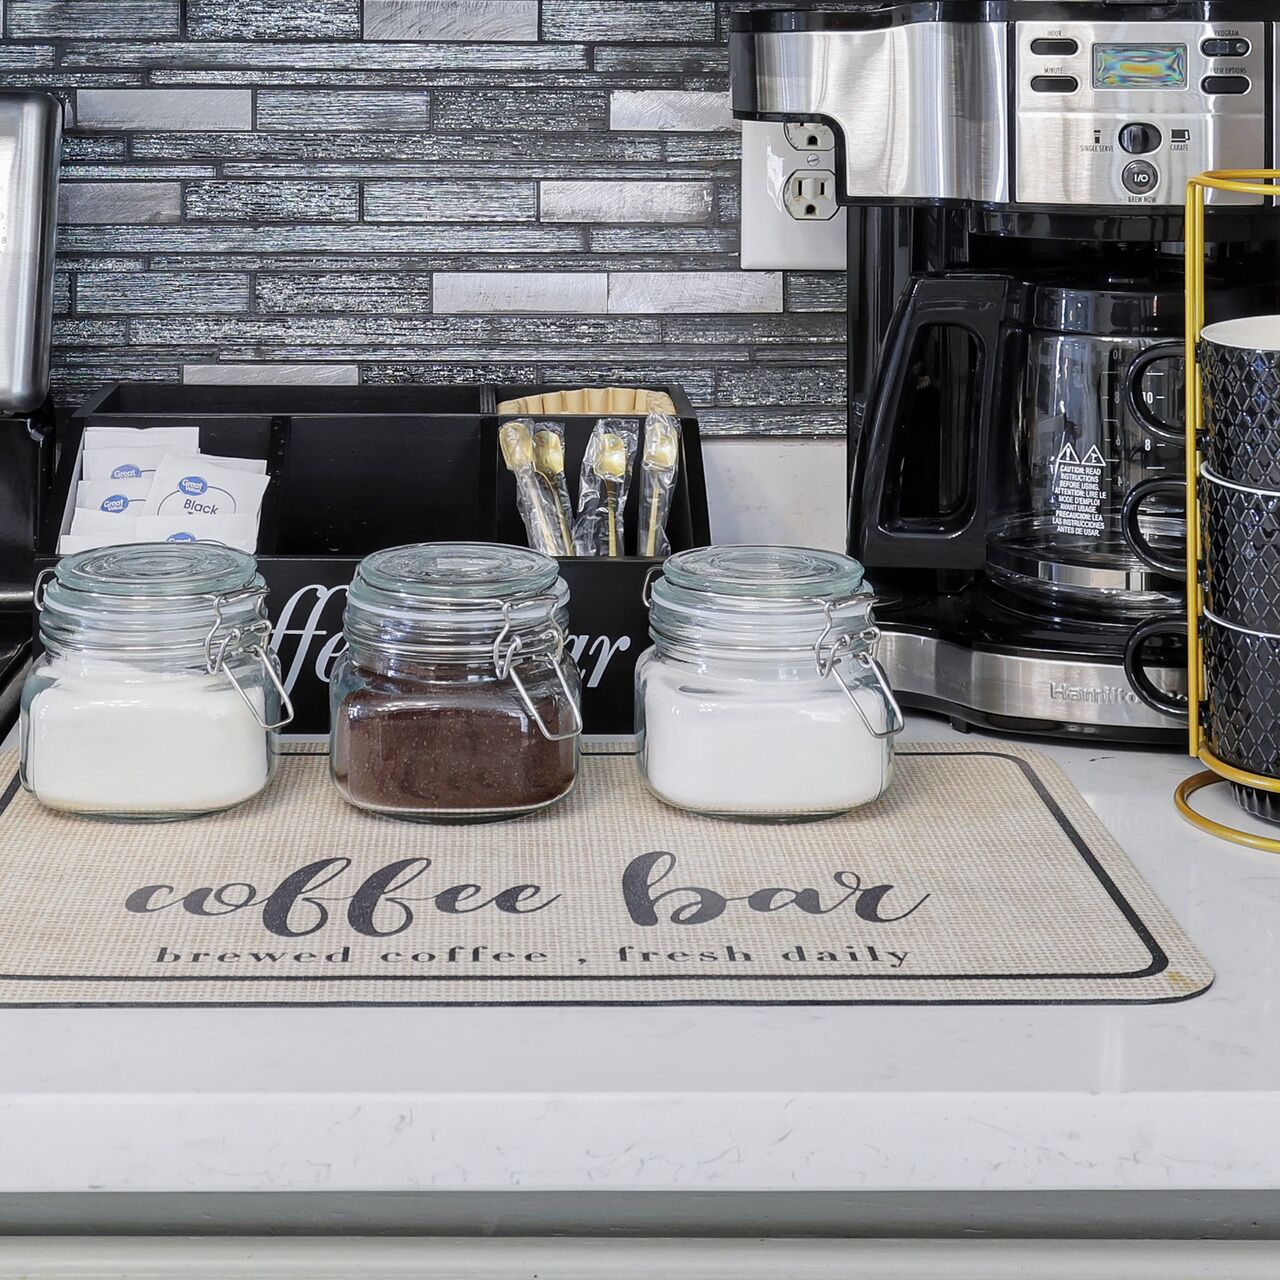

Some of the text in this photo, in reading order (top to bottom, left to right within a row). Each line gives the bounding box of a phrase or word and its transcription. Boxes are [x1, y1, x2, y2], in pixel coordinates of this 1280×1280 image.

[1214, 29, 1240, 37] PROGRAM
[1145, 439, 1151, 451] 8
[113, 469, 136, 478] Great
[1060, 465, 1085, 474] CAUTION:
[1061, 473, 1099, 482] INSTRUCTIONS
[181, 479, 203, 490] Great
[1060, 480, 1080, 489] BEFORE
[1055, 487, 1107, 499] ATTENTION: LIRE LE
[103, 500, 124, 509] Great
[1075, 497, 1100, 506] D'EMPLOI
[183, 498, 219, 515] Black
[1060, 503, 1077, 511] AVANT
[1063, 519, 1105, 529] INSTRUCCIONES
[1057, 525, 1074, 534] ANTES
[563, 634, 631, 688] ar
[1050, 682, 1142, 705] Hamilto
[125, 851, 931, 938] coffee bar
[156, 946, 351, 964] brewed
[380, 946, 548, 964] coffee
[619, 945, 753, 963] fresh
[783, 945, 914, 968] daily
